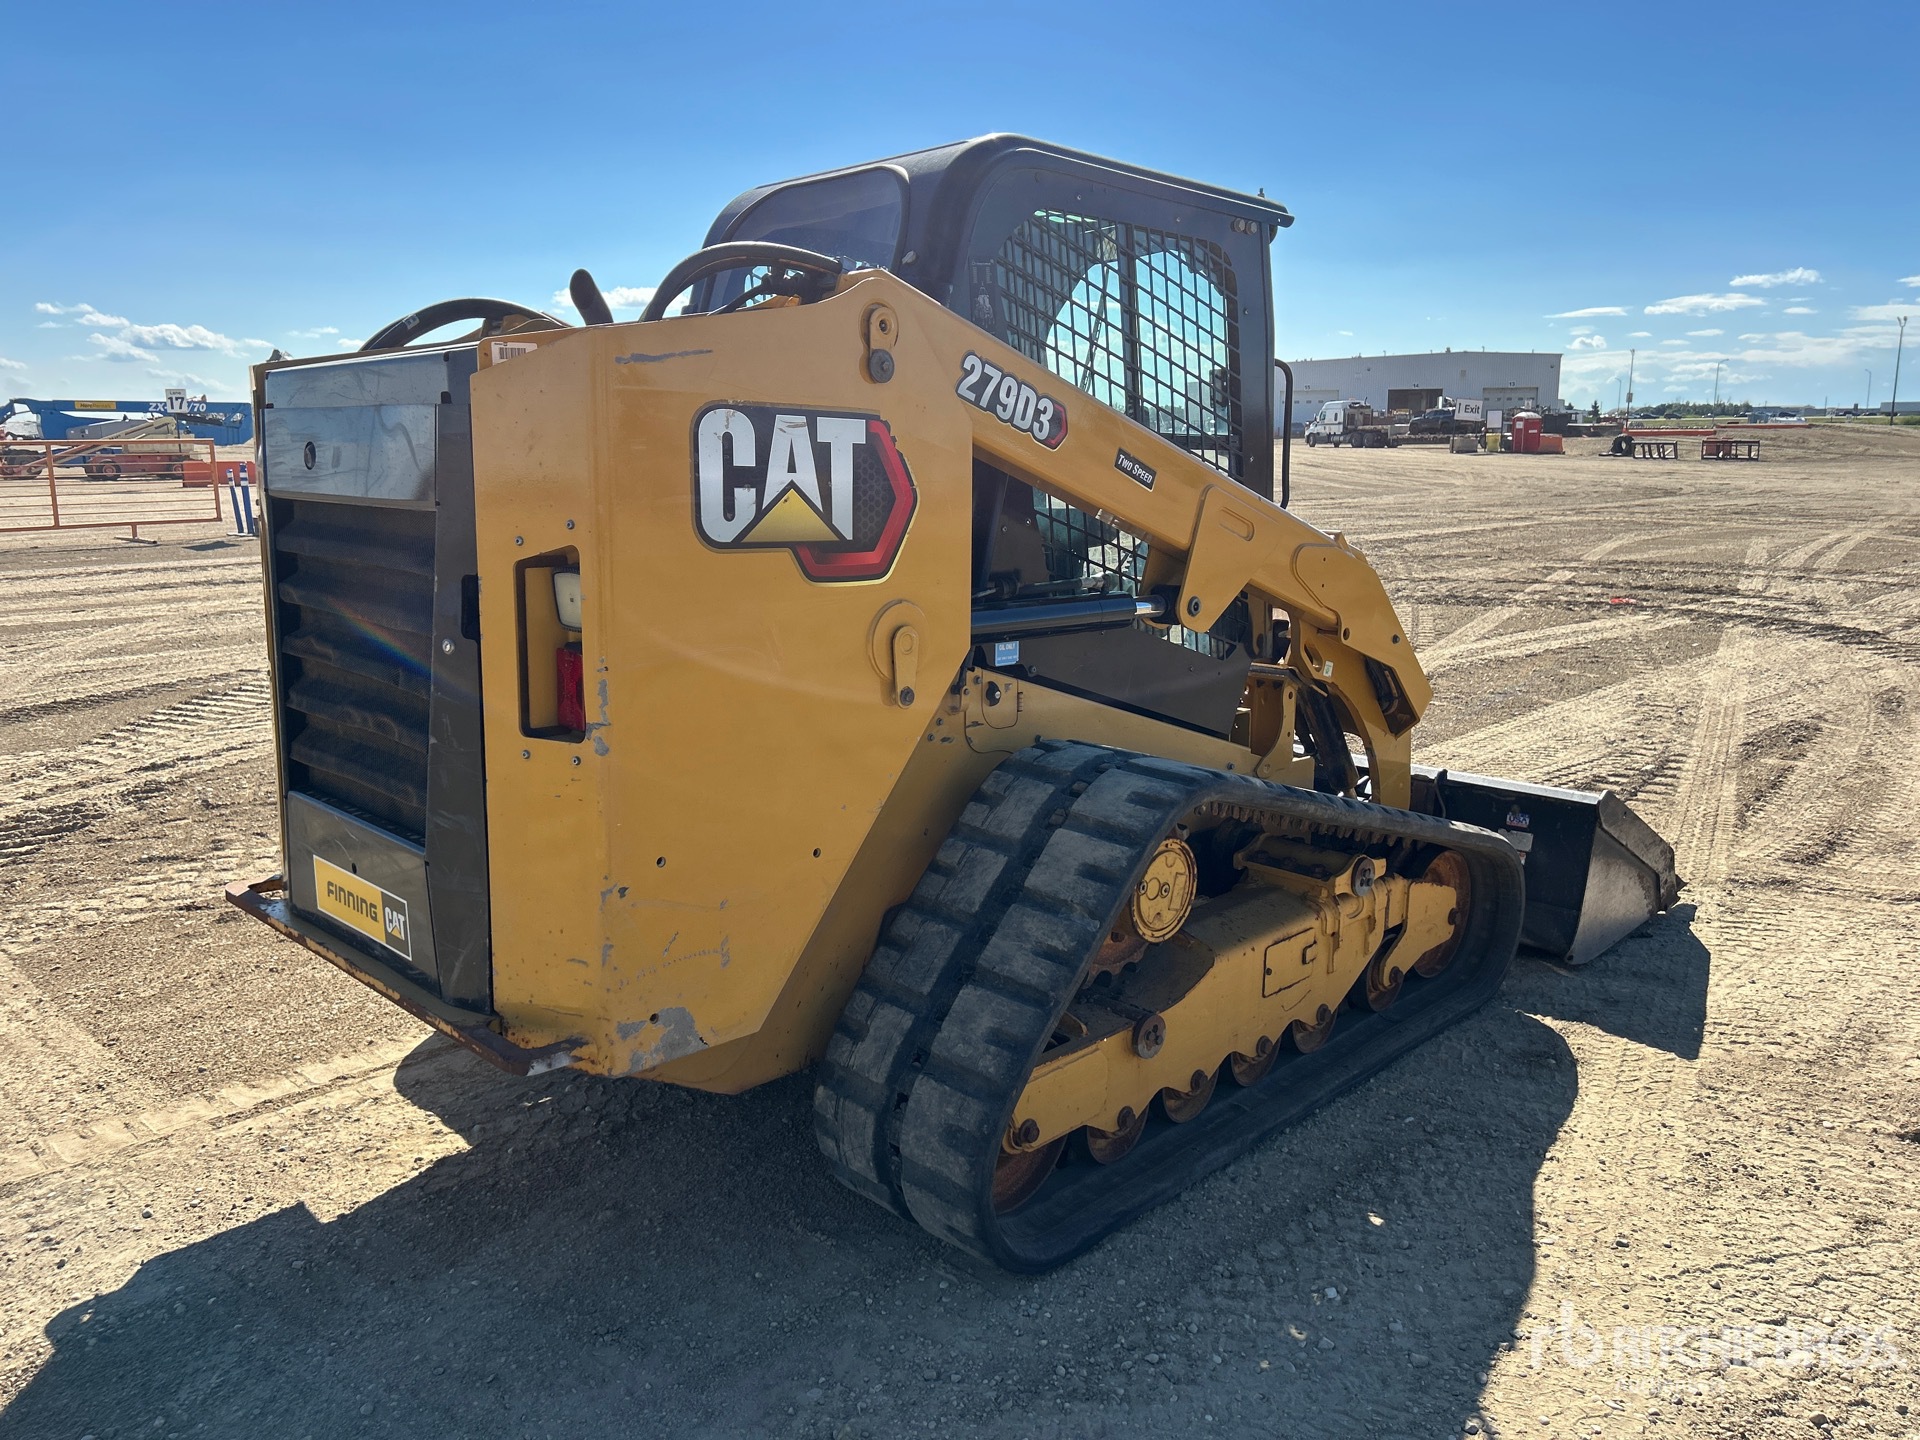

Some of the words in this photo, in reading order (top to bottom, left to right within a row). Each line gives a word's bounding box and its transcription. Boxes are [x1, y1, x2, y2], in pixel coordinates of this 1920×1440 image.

[167, 396, 185, 410] 17
[957, 354, 1054, 440] 279D3
[1464, 404, 1480, 414] Exit
[698, 408, 866, 543] CAT
[326, 880, 379, 923] FINNING
[384, 906, 405, 941] CAT
